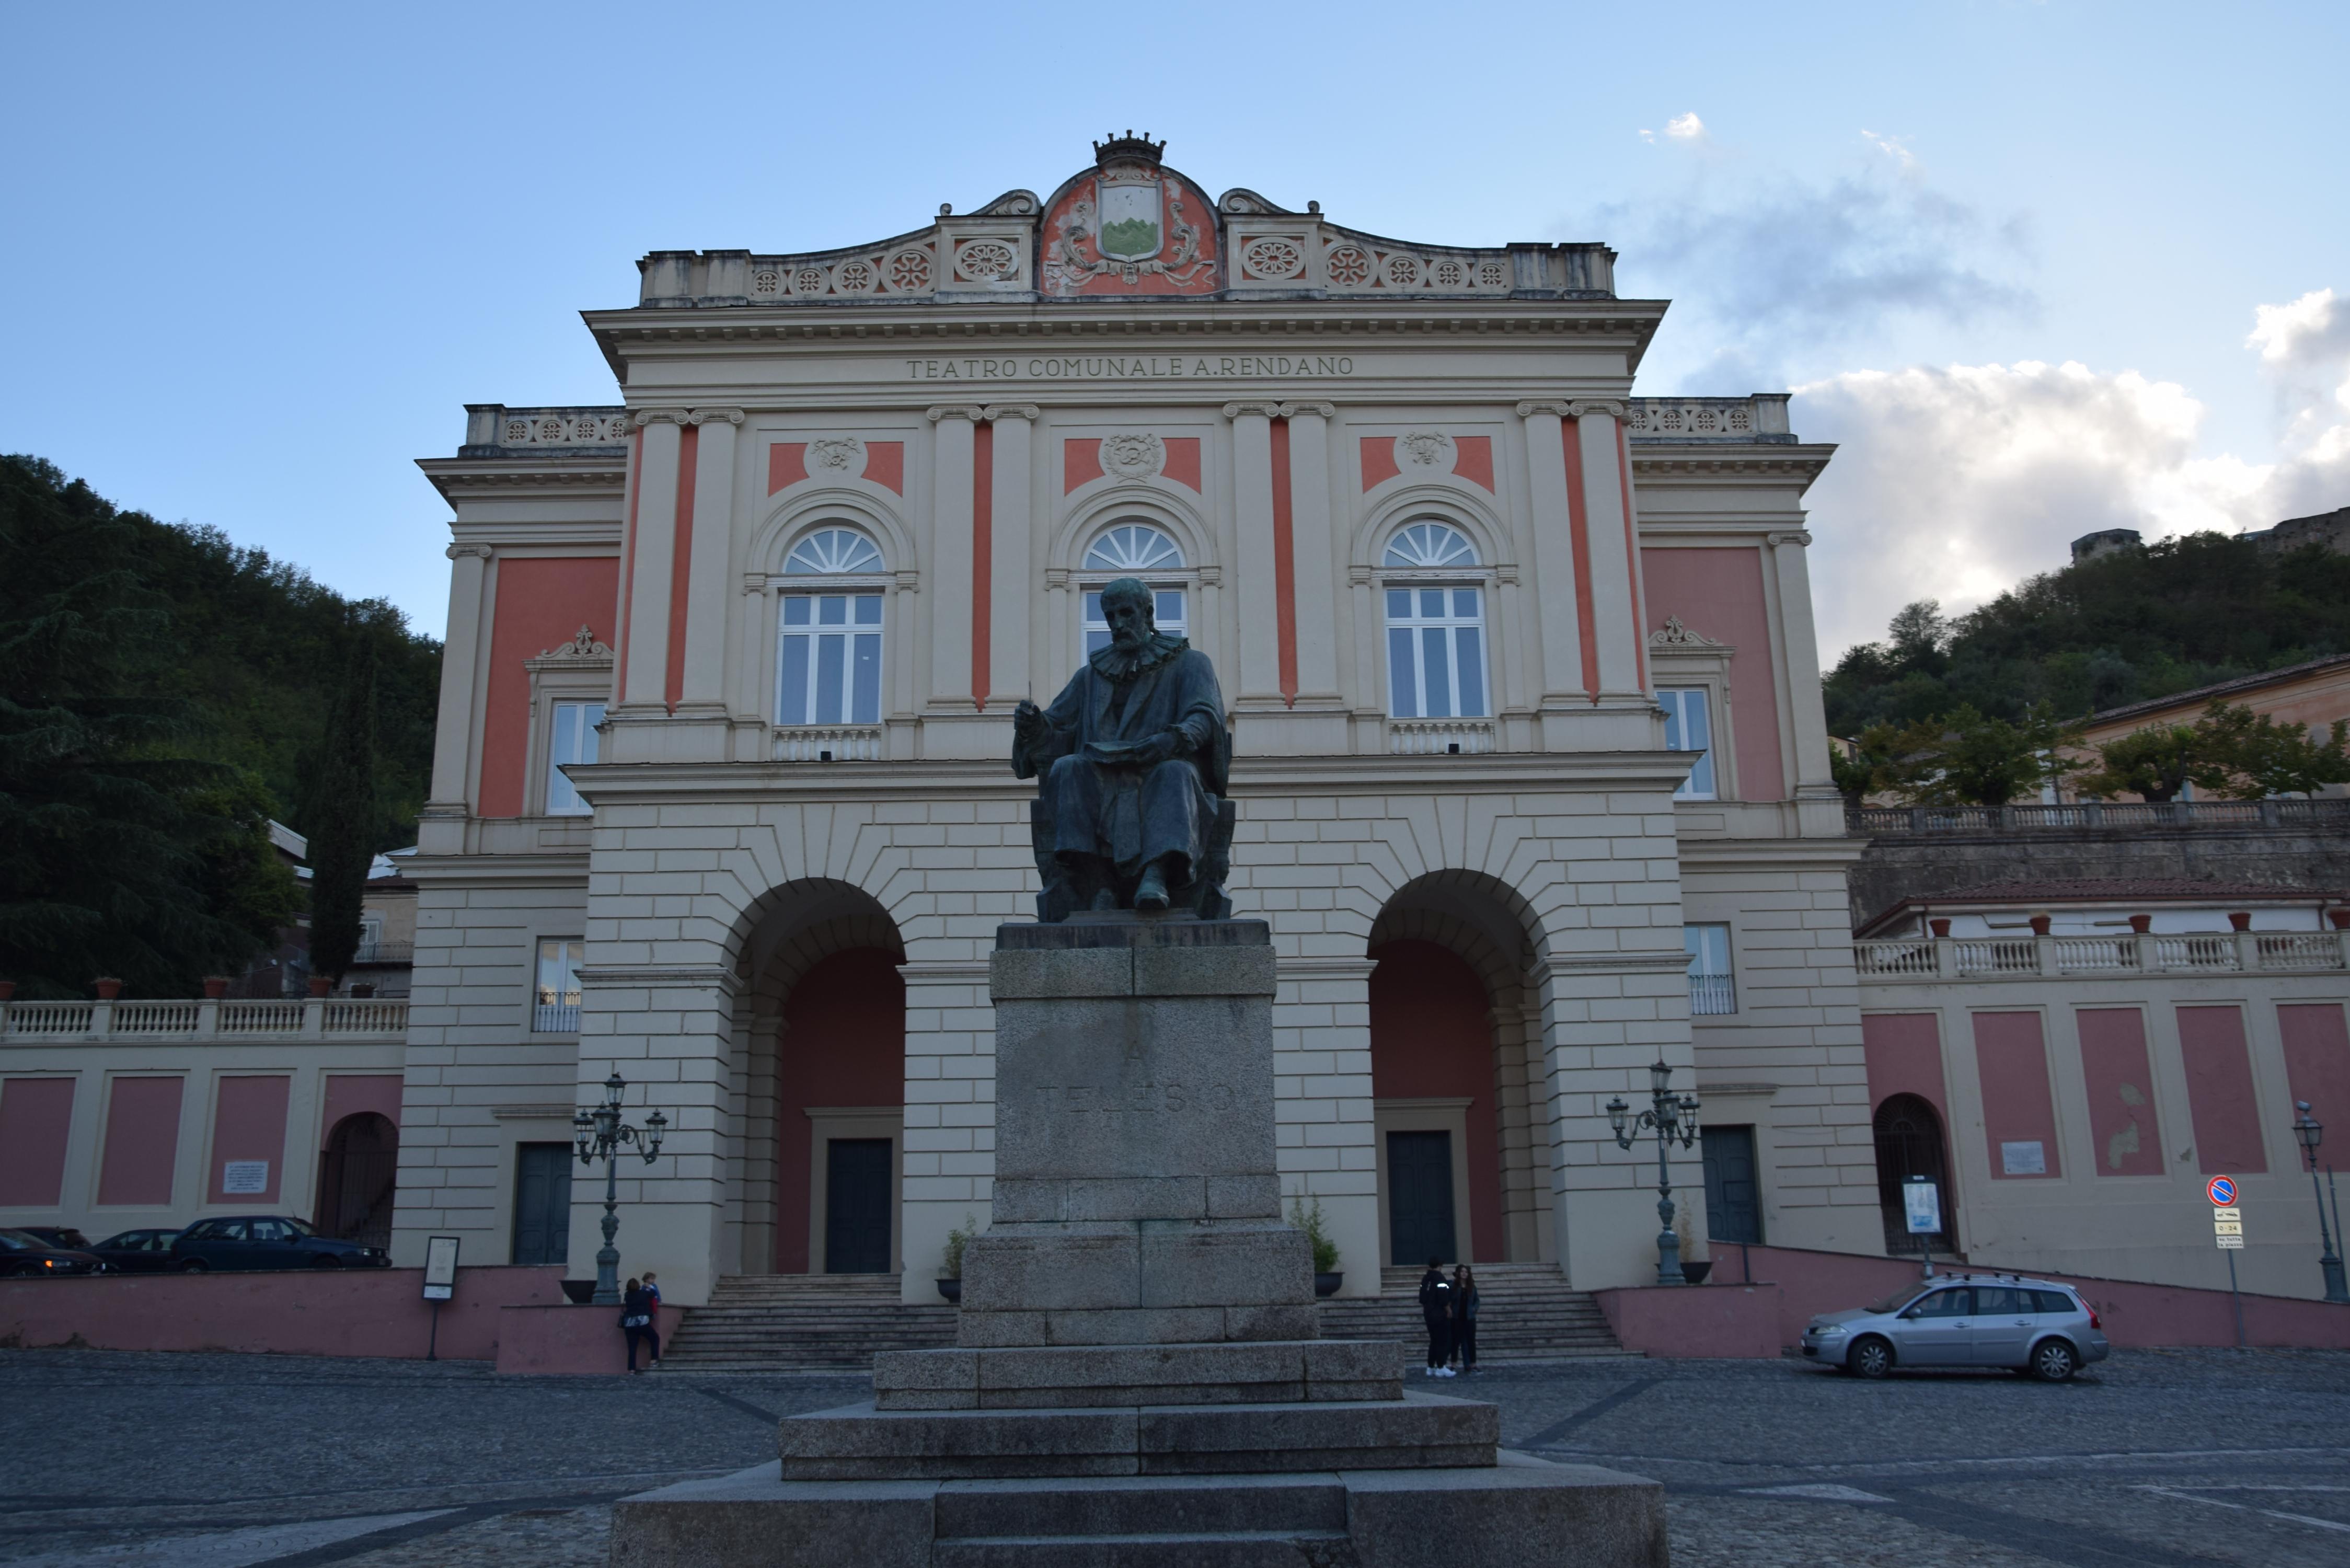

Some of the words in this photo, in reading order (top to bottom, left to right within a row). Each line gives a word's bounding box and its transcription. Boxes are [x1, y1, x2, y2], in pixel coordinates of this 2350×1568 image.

[907, 360, 1016, 378] TEATRO
[1029, 359, 1182, 377] COMUNALE
[1036, 1083, 1234, 1112] TELESO
